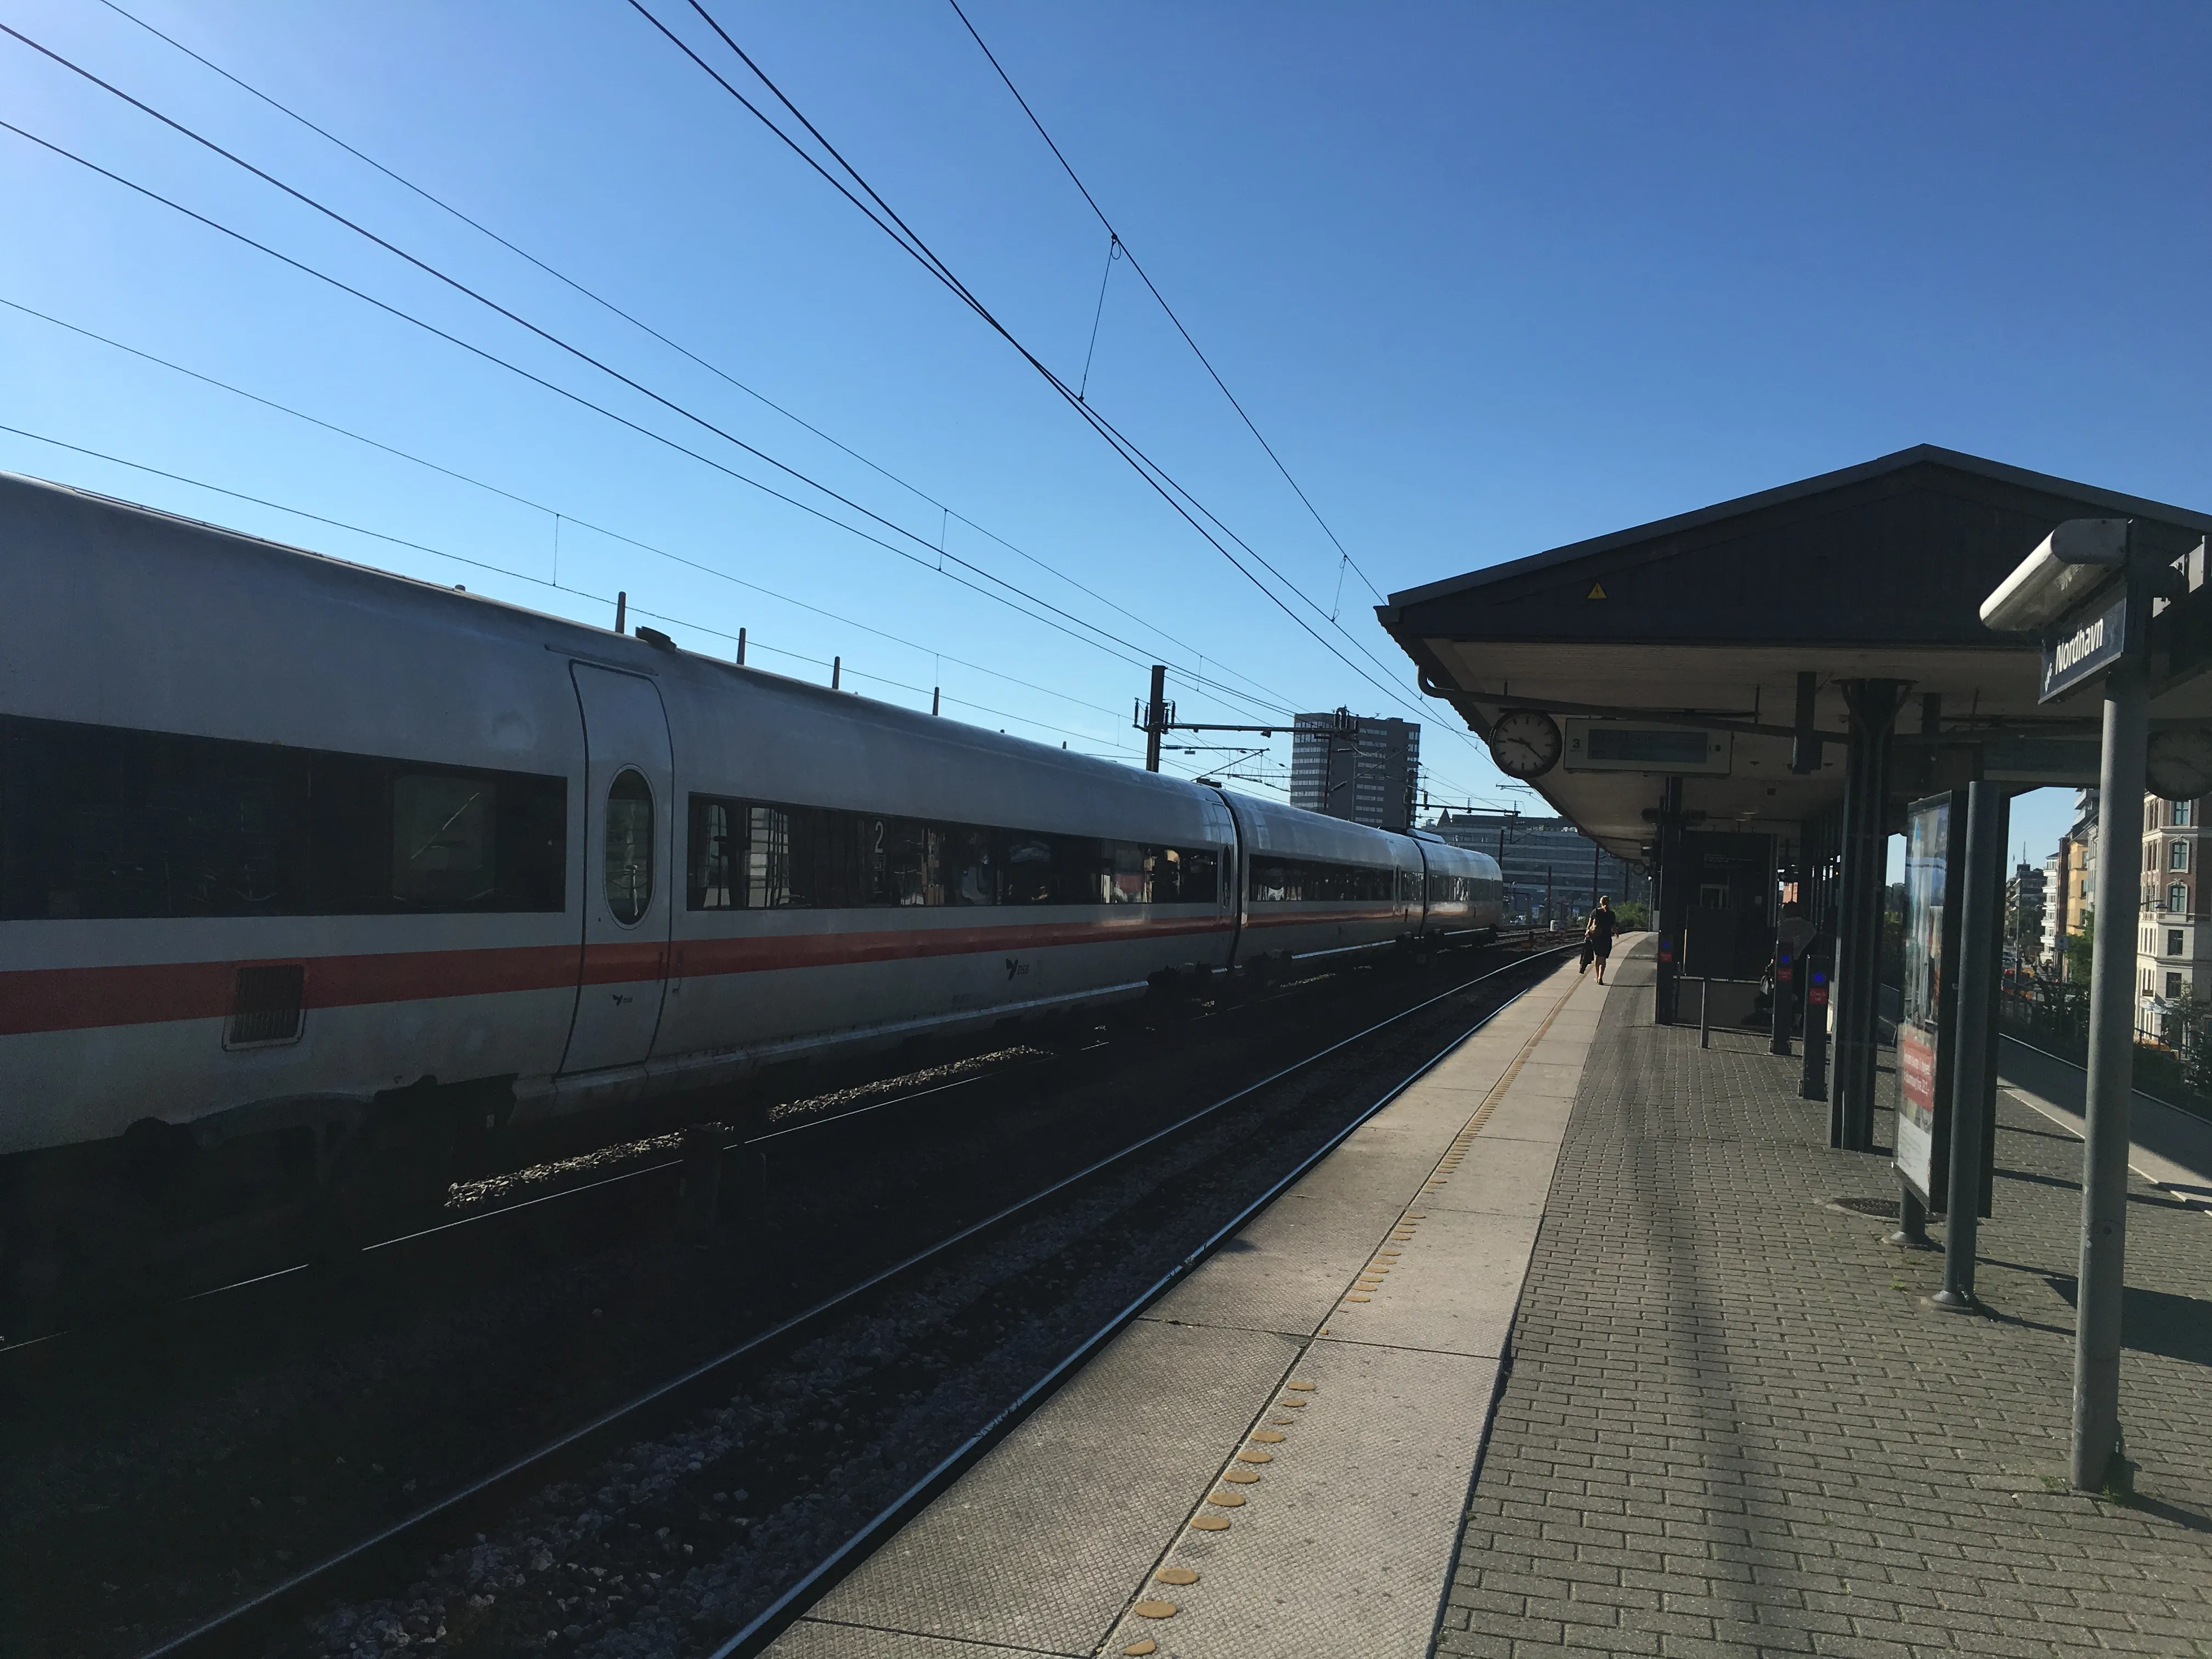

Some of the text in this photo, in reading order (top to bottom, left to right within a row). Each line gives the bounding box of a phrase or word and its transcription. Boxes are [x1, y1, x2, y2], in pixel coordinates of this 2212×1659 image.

[2055, 619, 2103, 675] Nordhavn
[1573, 738, 1580, 748] 3
[875, 821, 884, 853] 2
[1017, 964, 1029, 975] DSB
